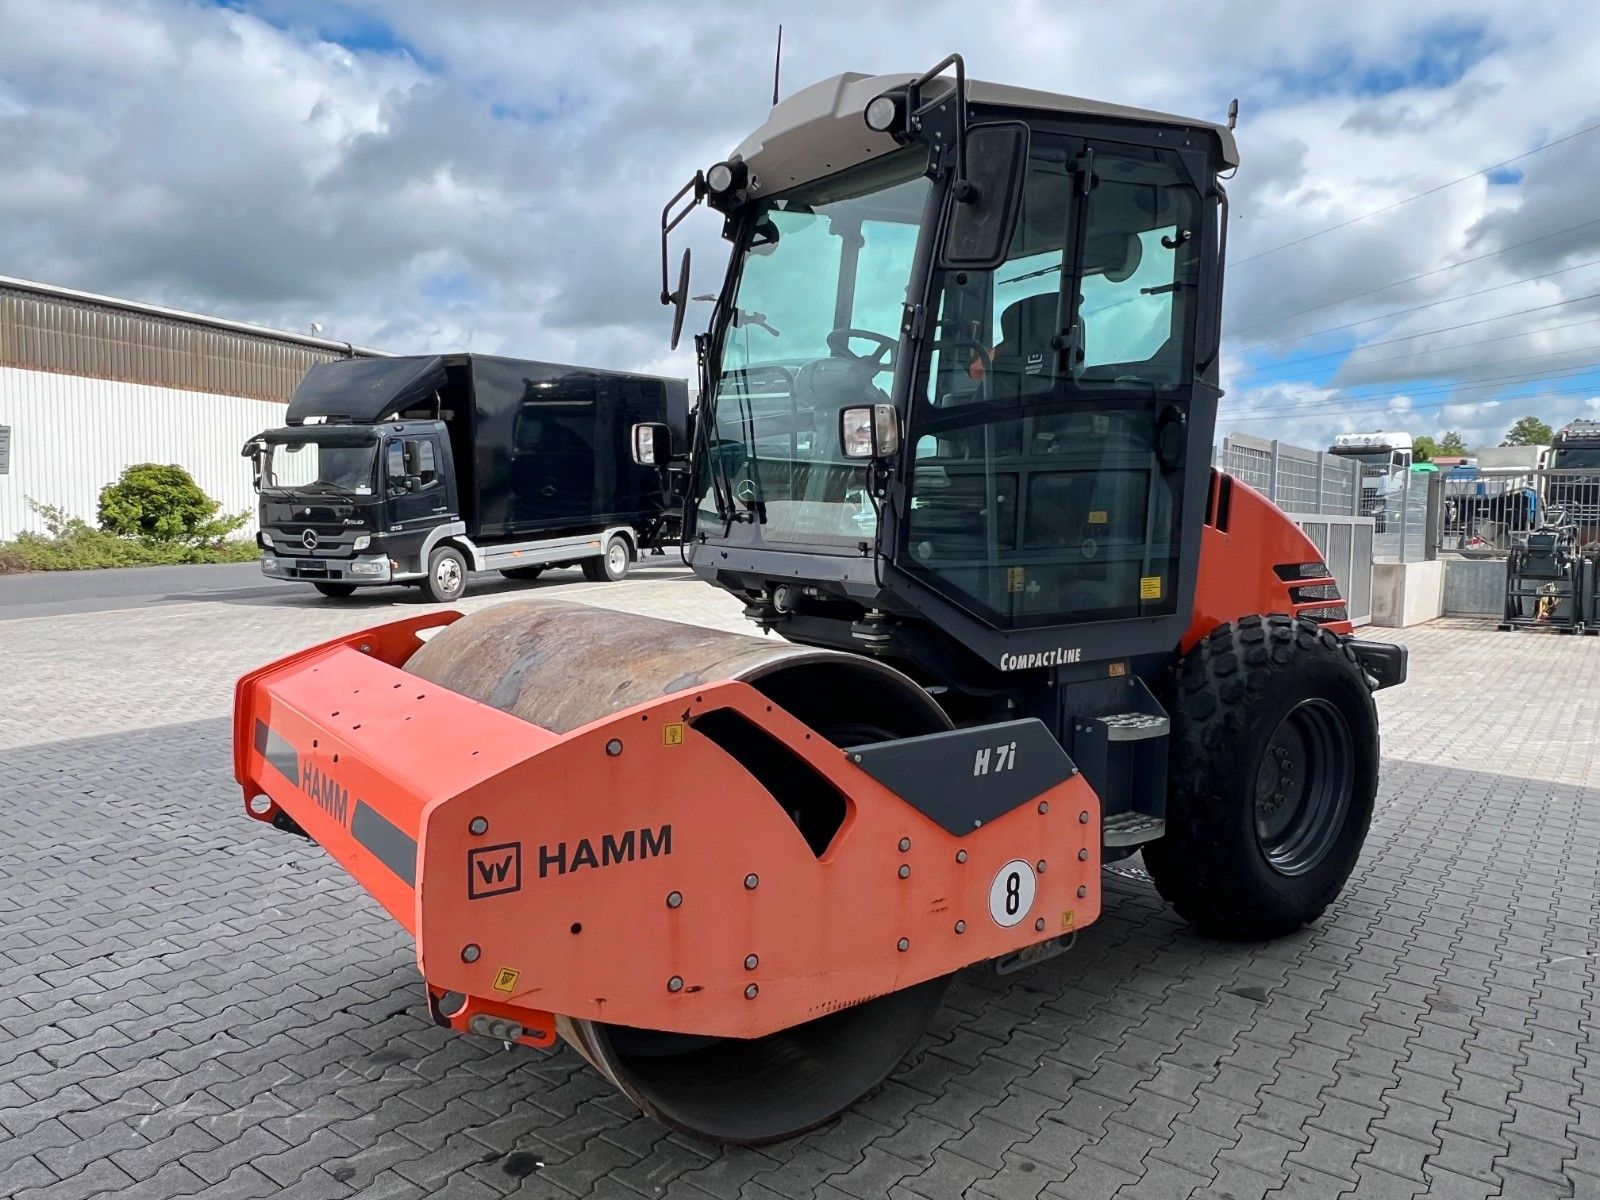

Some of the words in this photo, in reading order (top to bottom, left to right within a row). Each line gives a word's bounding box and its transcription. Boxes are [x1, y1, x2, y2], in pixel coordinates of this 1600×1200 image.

[973, 748, 991, 776] H
[995, 741, 1017, 772] 7i
[303, 759, 348, 828] HAMM
[539, 825, 672, 878] HAMM
[1006, 871, 1020, 916] 8
